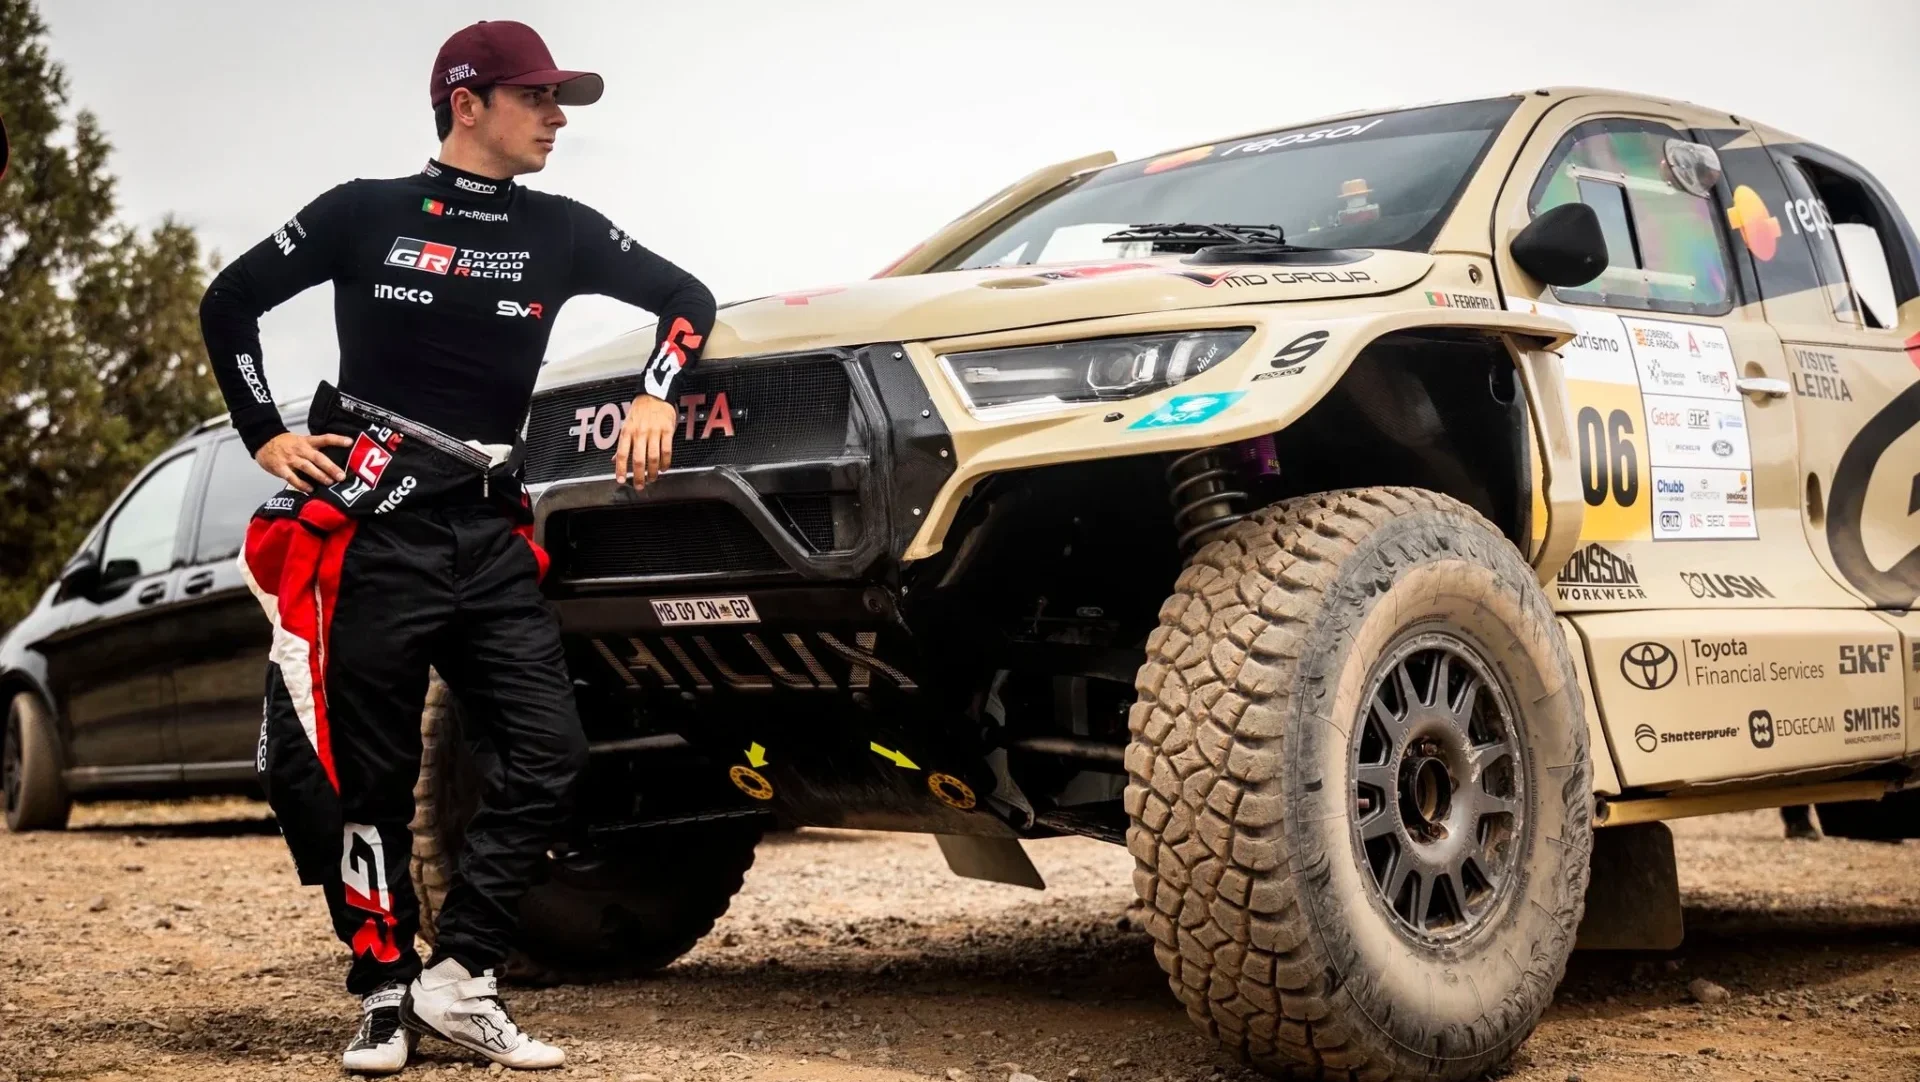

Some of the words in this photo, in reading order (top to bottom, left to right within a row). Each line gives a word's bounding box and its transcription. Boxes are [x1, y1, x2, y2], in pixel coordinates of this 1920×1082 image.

[445, 68, 478, 85] LEIRIA
[1220, 119, 1384, 156] repsol
[454, 177, 497, 194] sparco
[445, 207, 455, 216] J.
[458, 209, 509, 223] FERREIRA
[388, 248, 450, 273] GR
[457, 259, 524, 269] GAZOO
[460, 249, 531, 260] TOYOTA
[454, 267, 522, 282] Racing
[1223, 276, 1268, 288] MD
[496, 300, 543, 319] SVR
[1195, 343, 1219, 373] HILUX
[1793, 348, 1839, 374] VISITE
[236, 353, 272, 404] sparco
[1792, 371, 1853, 402] LEIRIA
[575, 391, 736, 453] TOTA
[1651, 407, 1681, 427] Getac
[1578, 406, 1638, 507] 06
[1657, 479, 1685, 493] Chubb
[1661, 514, 1680, 528] CRUZ
[1556, 543, 1639, 584] JONSSON
[1557, 587, 1647, 601] WORKWEAR
[1703, 573, 1777, 598] USN
[654, 603, 677, 622] MB
[675, 602, 696, 621] 09
[696, 601, 722, 619] CN
[729, 599, 750, 618] GP
[591, 631, 919, 688] HILUX
[1691, 638, 1747, 661] Toyota
[1839, 644, 1894, 674] SKF
[1695, 661, 1766, 685] Financial
[1770, 661, 1824, 681] Services
[1776, 716, 1835, 737] EDGECAM
[1843, 705, 1901, 732] SMITHS
